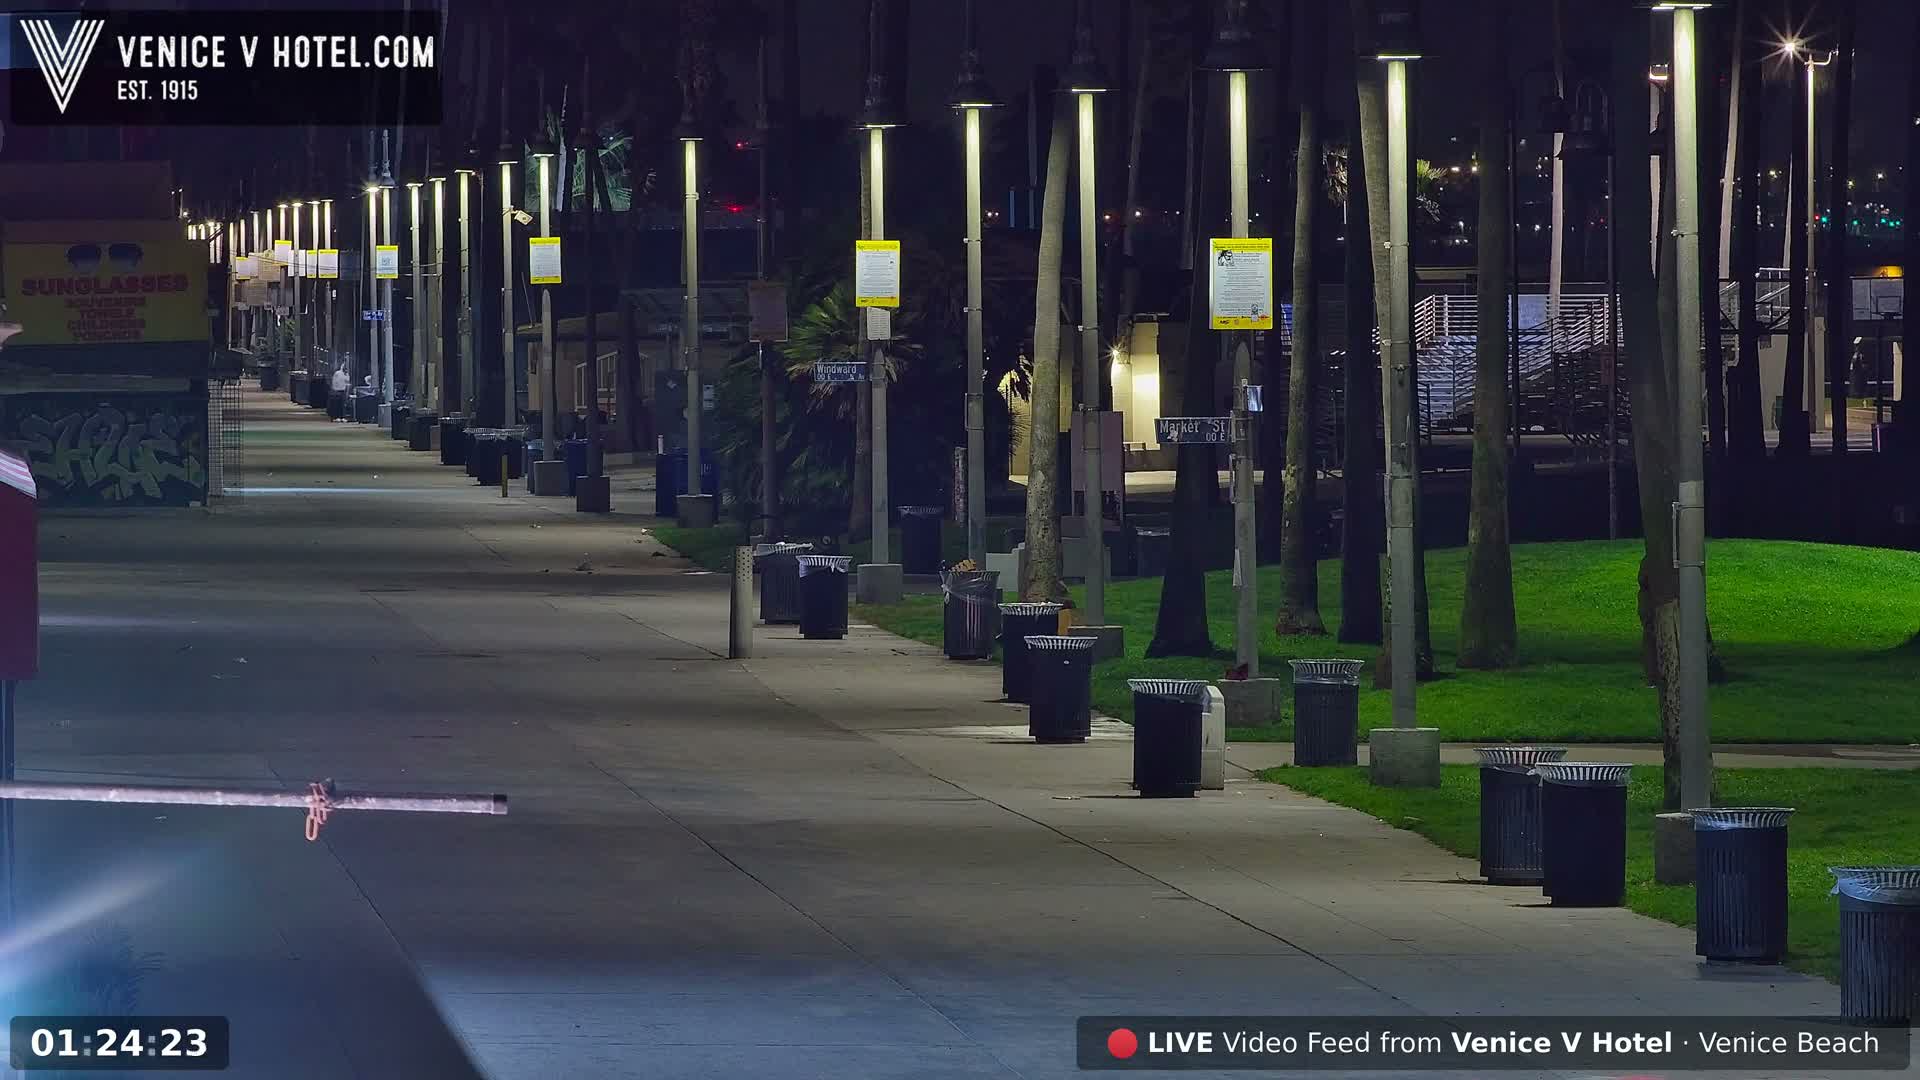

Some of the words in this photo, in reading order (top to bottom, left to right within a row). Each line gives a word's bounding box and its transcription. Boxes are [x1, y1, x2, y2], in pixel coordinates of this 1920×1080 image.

[21, 273, 189, 296] SUNGLASSES
[816, 364, 857, 374] Windward
[1160, 419, 1199, 433] Market
[1212, 419, 1225, 433] St
[1205, 432, 1217, 442] 00
[1220, 432, 1225, 441] E
